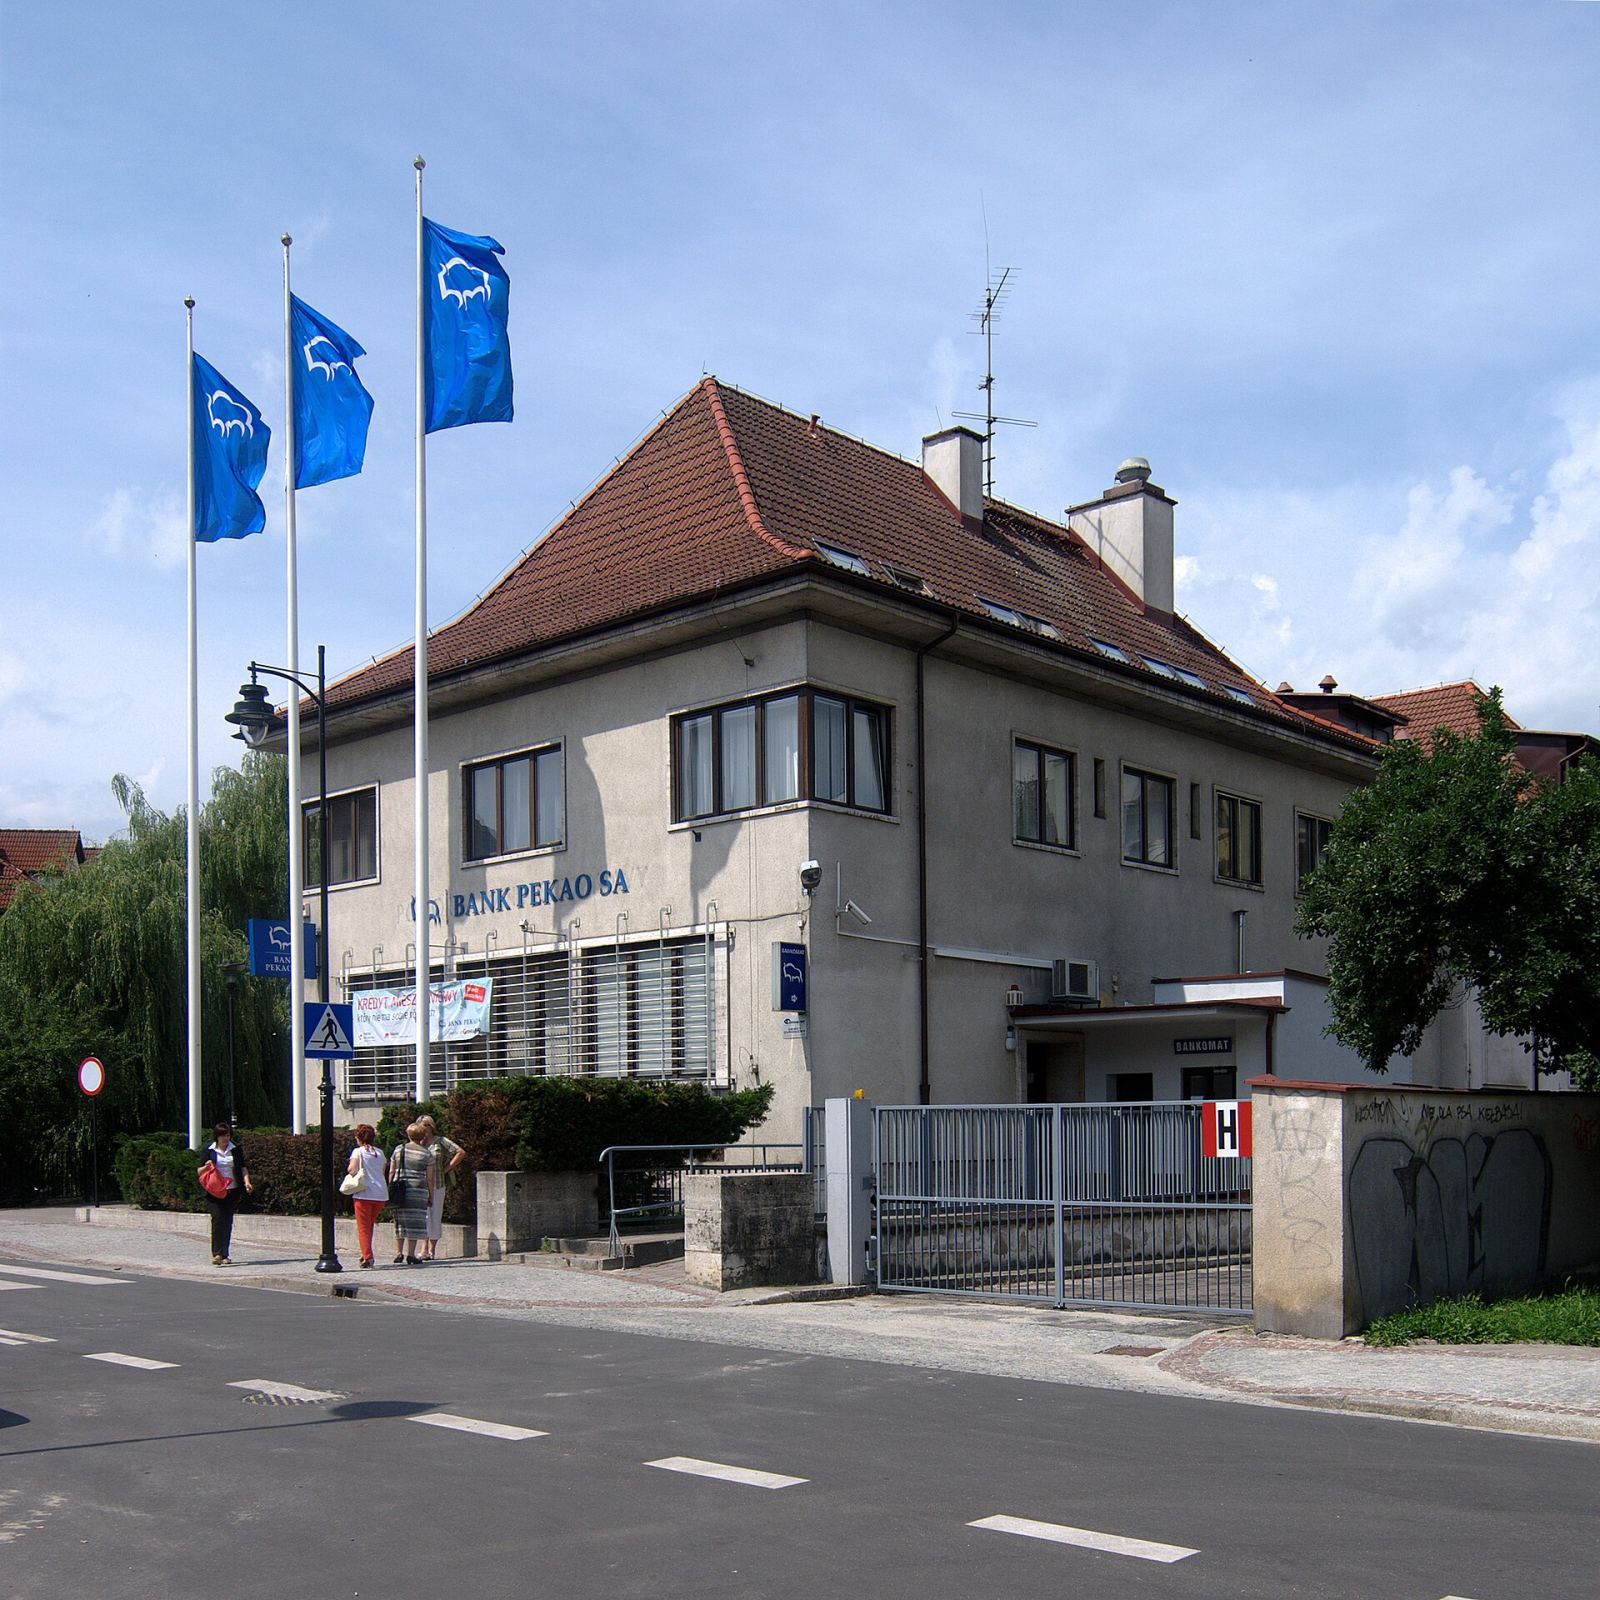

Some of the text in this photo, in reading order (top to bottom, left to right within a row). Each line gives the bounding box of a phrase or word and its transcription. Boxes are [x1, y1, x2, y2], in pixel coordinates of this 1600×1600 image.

[453, 868, 630, 917] BANK PEKAO SA
[274, 956, 291, 964] BAN
[357, 996, 389, 1011] KREDYT
[1176, 1040, 1229, 1052] BANKOMAT
[1217, 1110, 1237, 1150] H
